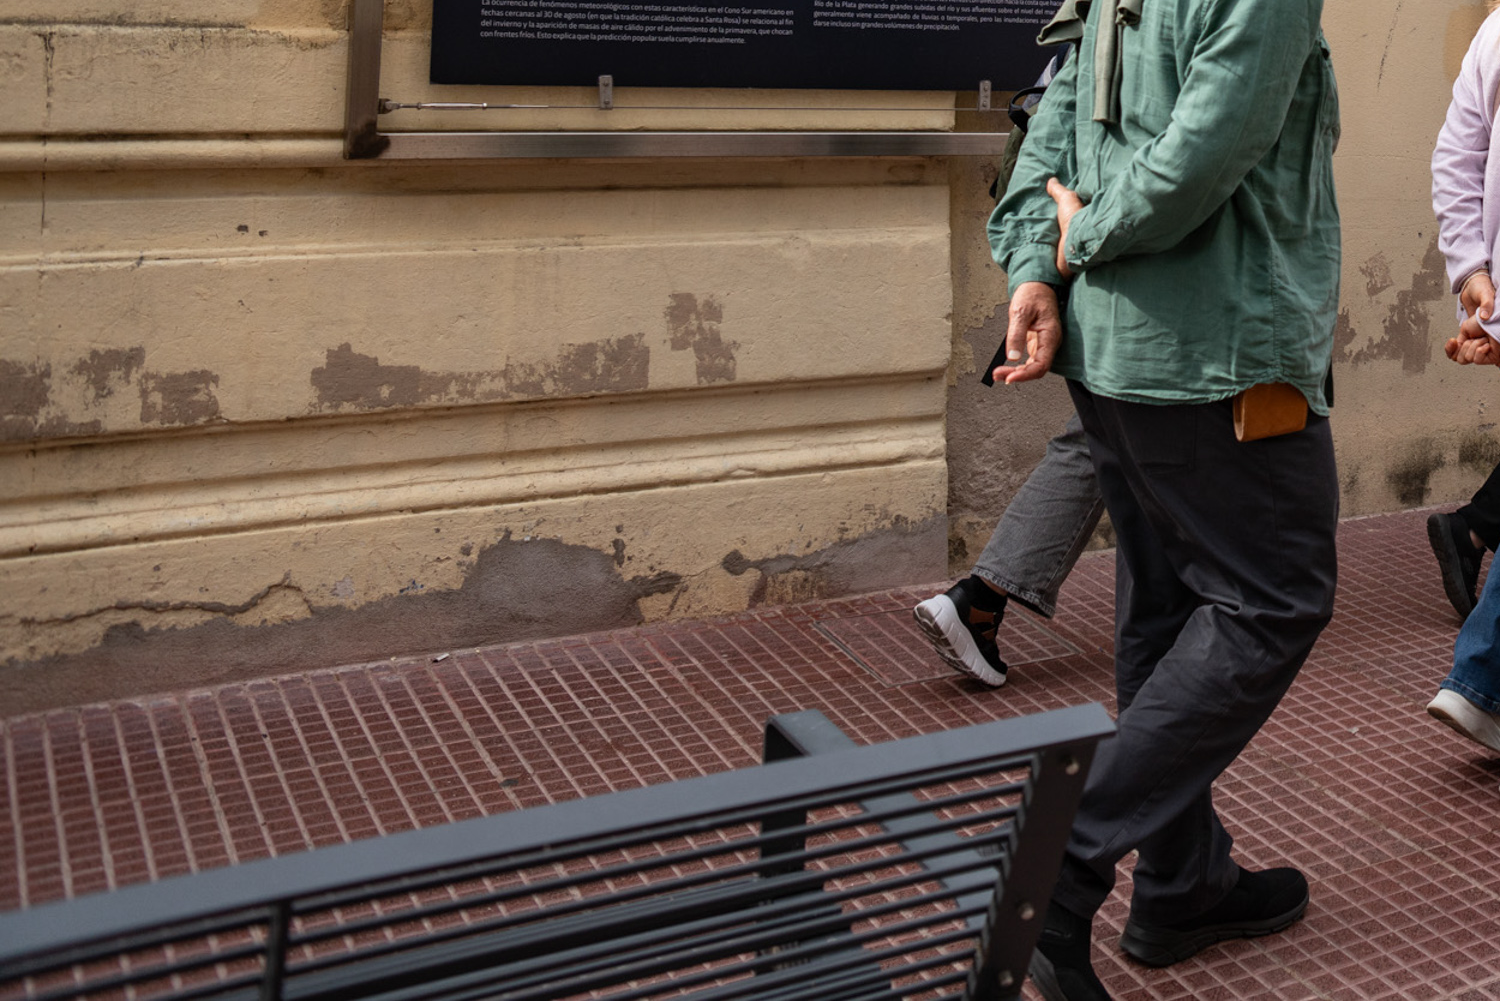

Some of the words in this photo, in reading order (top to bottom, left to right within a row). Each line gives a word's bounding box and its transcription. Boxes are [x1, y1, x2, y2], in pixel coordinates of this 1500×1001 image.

[539, 0, 578, 9] fenómenos
[579, 3, 630, 12] meteorológicos
[662, 5, 707, 13] características
